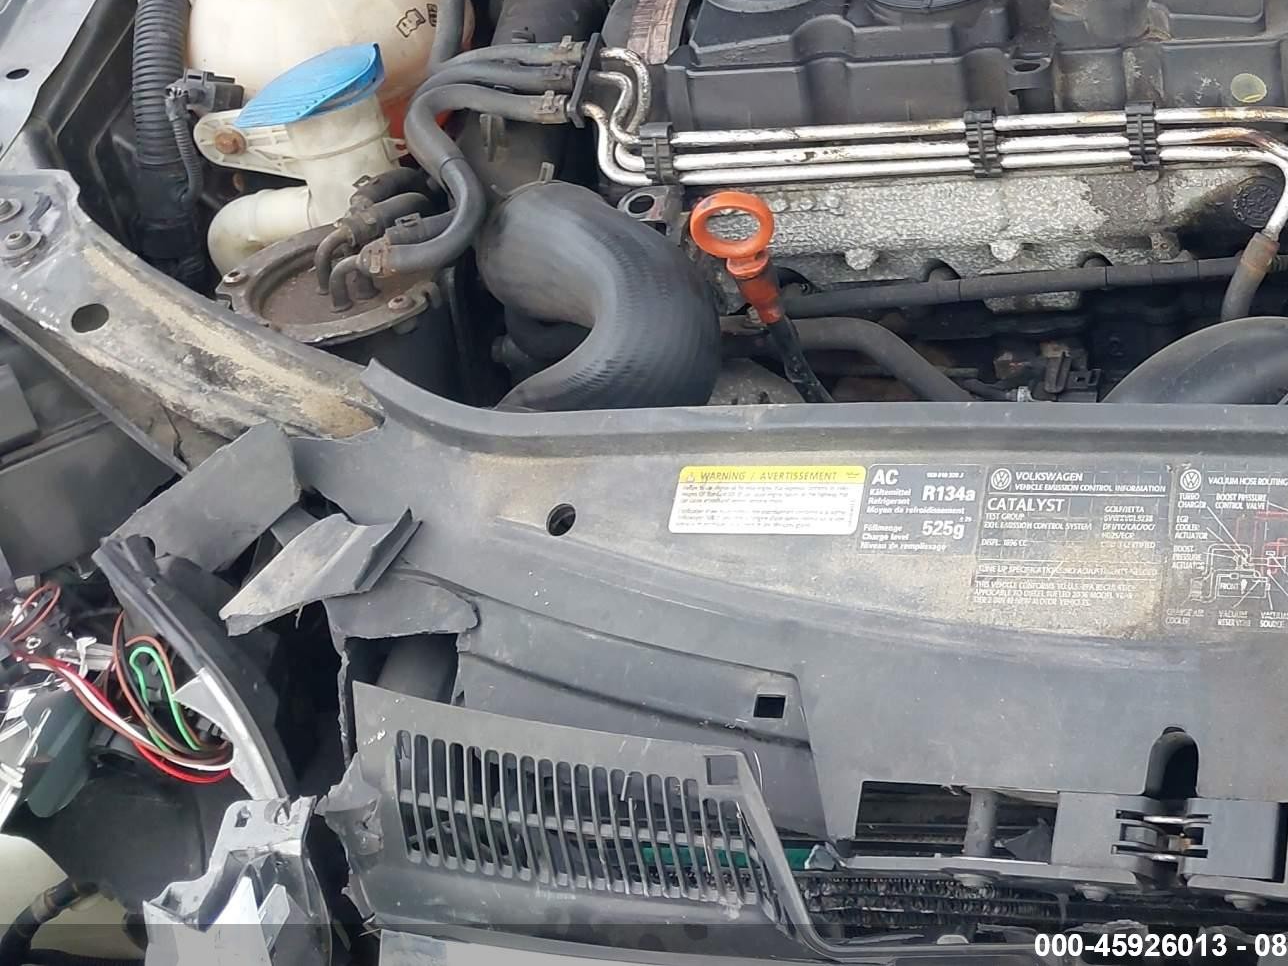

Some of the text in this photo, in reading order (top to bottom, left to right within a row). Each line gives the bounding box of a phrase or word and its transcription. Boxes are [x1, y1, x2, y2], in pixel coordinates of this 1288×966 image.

[700, 471, 745, 481] WARNING
[760, 471, 838, 481] AVERTISSEMENT
[871, 469, 899, 485] AC
[1015, 471, 1083, 482] VOLKSWAGEN
[1208, 477, 1238, 485] VACUUM
[1239, 477, 1257, 485] HOSE
[1258, 477, 1288, 486] ROUTING
[922, 485, 976, 501] R134a
[1014, 483, 1043, 491] VEHICLE
[1080, 484, 1112, 492] CONTROL
[1114, 485, 1166, 493] INFORMATION
[867, 497, 911, 506] Refrigerant
[1216, 493, 1266, 501] BOOST PRESSURE
[987, 497, 1065, 512] CATALYST
[866, 506, 892, 515] Moyen
[905, 506, 965, 514] refroidissement
[985, 512, 1025, 521] TEST GROUP
[922, 520, 965, 540] 525g
[1033, 522, 1064, 530] CONTROL
[1065, 523, 1092, 531] SYSTEM
[862, 533, 909, 542] Charge level
[860, 541, 887, 549] Niveau
[900, 542, 947, 552] remplissage
